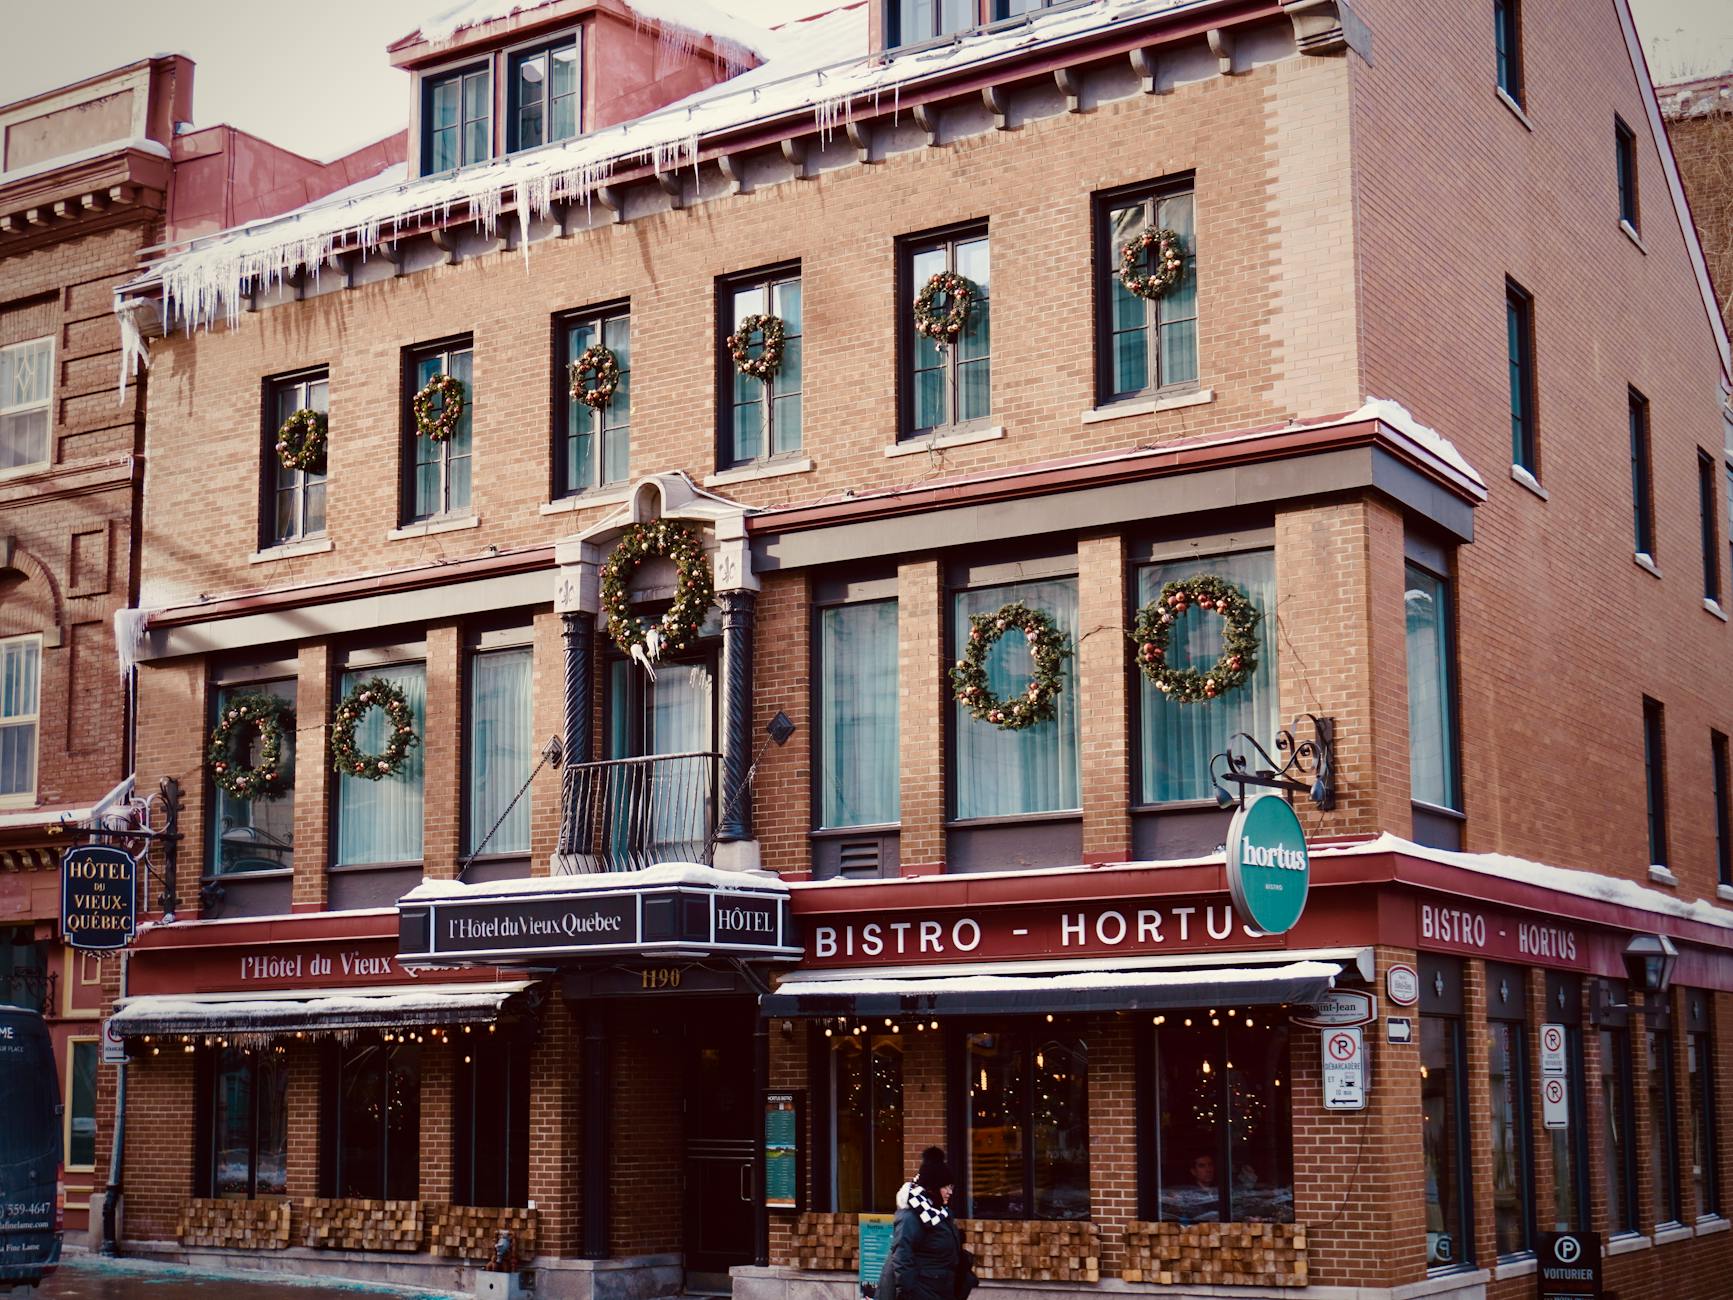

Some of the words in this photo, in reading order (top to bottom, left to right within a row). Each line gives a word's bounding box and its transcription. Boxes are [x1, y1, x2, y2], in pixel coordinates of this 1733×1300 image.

[1242, 836, 1306, 871] hortus
[70, 857, 130, 880] HÔTEL
[94, 883, 106, 891] DU
[75, 894, 127, 910] VIEUX-
[68, 911, 131, 932] QUÉBEC
[500, 916, 519, 936] du
[518, 914, 561, 935] Vieux
[562, 911, 621, 937] Québec
[718, 906, 774, 932] HÔTEL
[815, 918, 981, 957] BISTRO
[1061, 906, 1263, 946] HORTU
[1422, 905, 1486, 947] BISTRO
[1518, 923, 1576, 961] HORTUS
[240, 954, 302, 980] l'Hôtel
[310, 953, 331, 976] du
[340, 951, 392, 975] Vieux
[641, 968, 681, 988] 1190
[1311, 1002, 1356, 1013] aint-Jean
[8, 1202, 51, 1217] 559-4647
[1563, 1241, 1574, 1258] P
[1543, 1267, 1593, 1280] VOITURIER
